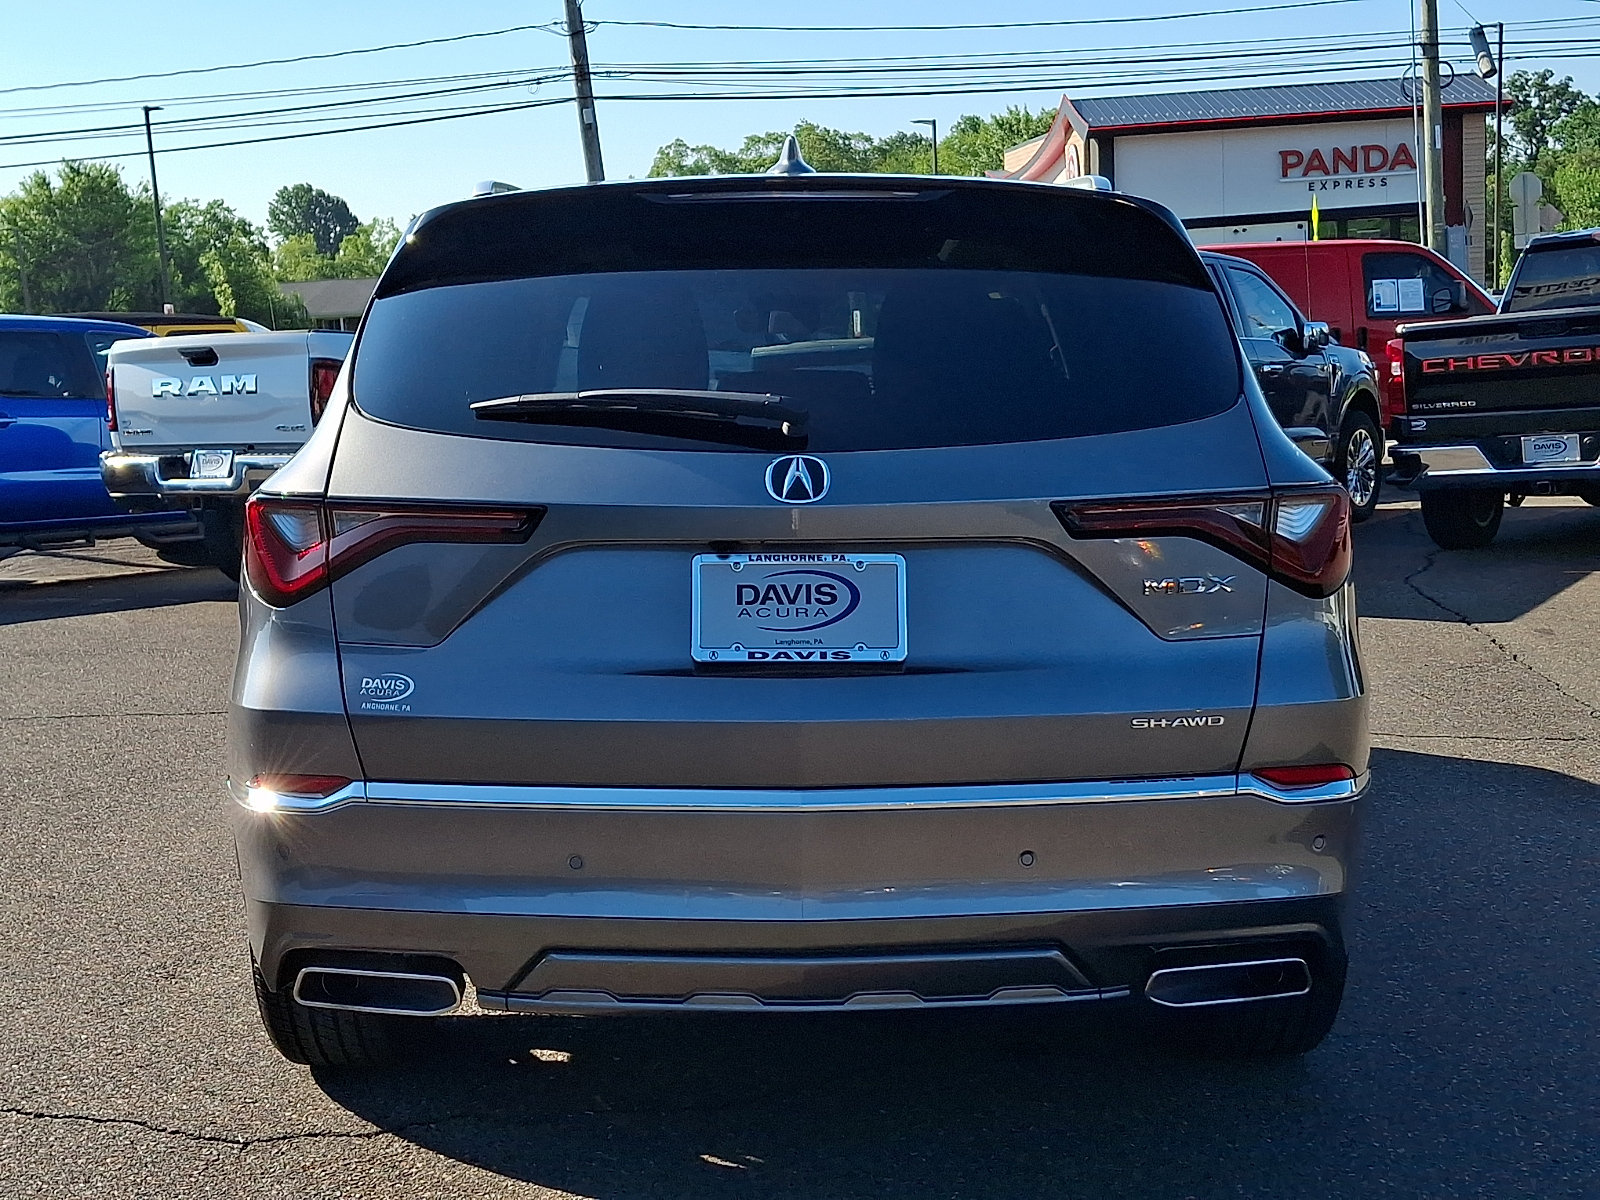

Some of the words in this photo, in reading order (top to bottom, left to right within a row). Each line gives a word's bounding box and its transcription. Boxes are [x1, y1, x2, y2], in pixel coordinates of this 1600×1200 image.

[1278, 143, 1417, 178] PANDA
[1308, 177, 1388, 192] EXPRESS
[1422, 347, 1600, 373] CHEVRO
[151, 374, 258, 398] RAM
[1411, 400, 1477, 410] SILVERADO
[1533, 442, 1562, 451] DAVIS
[1143, 575, 1237, 596] MDX
[736, 583, 838, 606] DAVIS
[737, 607, 829, 618] ACURA
[747, 651, 852, 660] DAVIS
[361, 677, 406, 689] DAVIS
[360, 688, 400, 697] ACURA
[401, 704, 412, 712] PA
